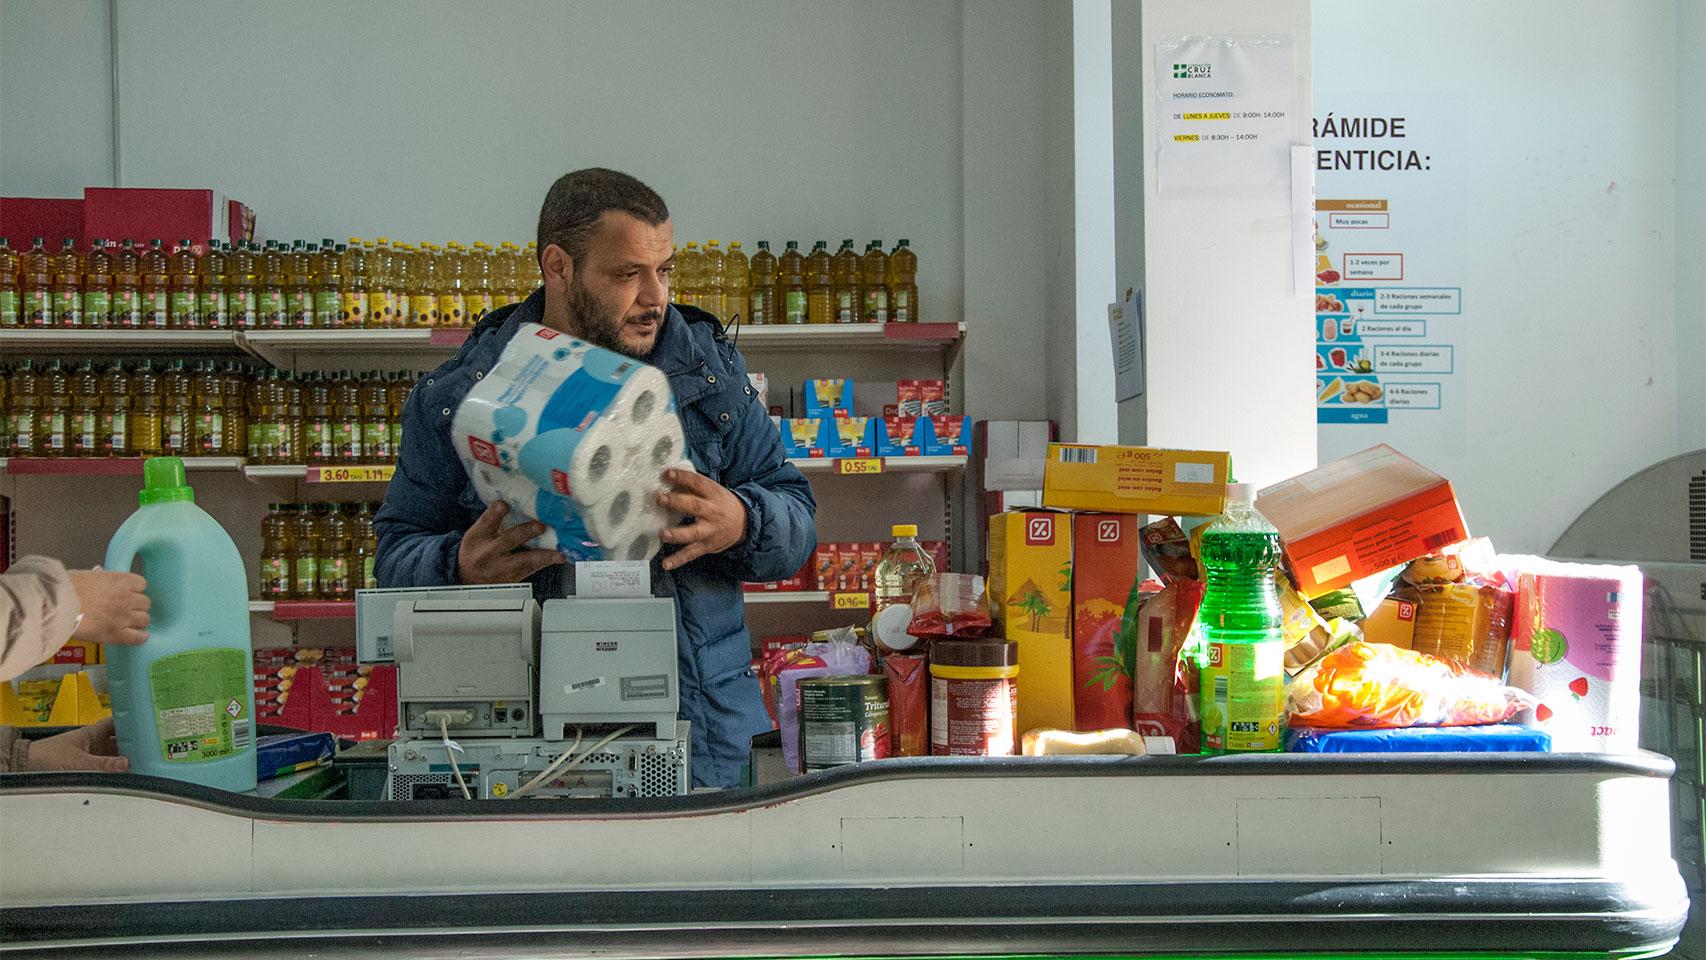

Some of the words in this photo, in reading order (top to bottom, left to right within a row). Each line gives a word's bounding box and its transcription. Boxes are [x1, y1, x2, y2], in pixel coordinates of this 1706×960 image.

[1317, 150, 1431, 170] ENTICIA:
[1345, 201, 1382, 209] ocasional
[1335, 218, 1350, 226] Muy
[1351, 218, 1368, 226] pocas
[1350, 289, 1374, 298] diario
[1350, 412, 1368, 420] agua
[1134, 452, 1151, 460] 500
[844, 461, 867, 473] 0.55
[324, 469, 349, 481] 3.60
[365, 469, 383, 480] 1.19
[1375, 558, 1390, 569] 500
[837, 597, 858, 607] 0.96
